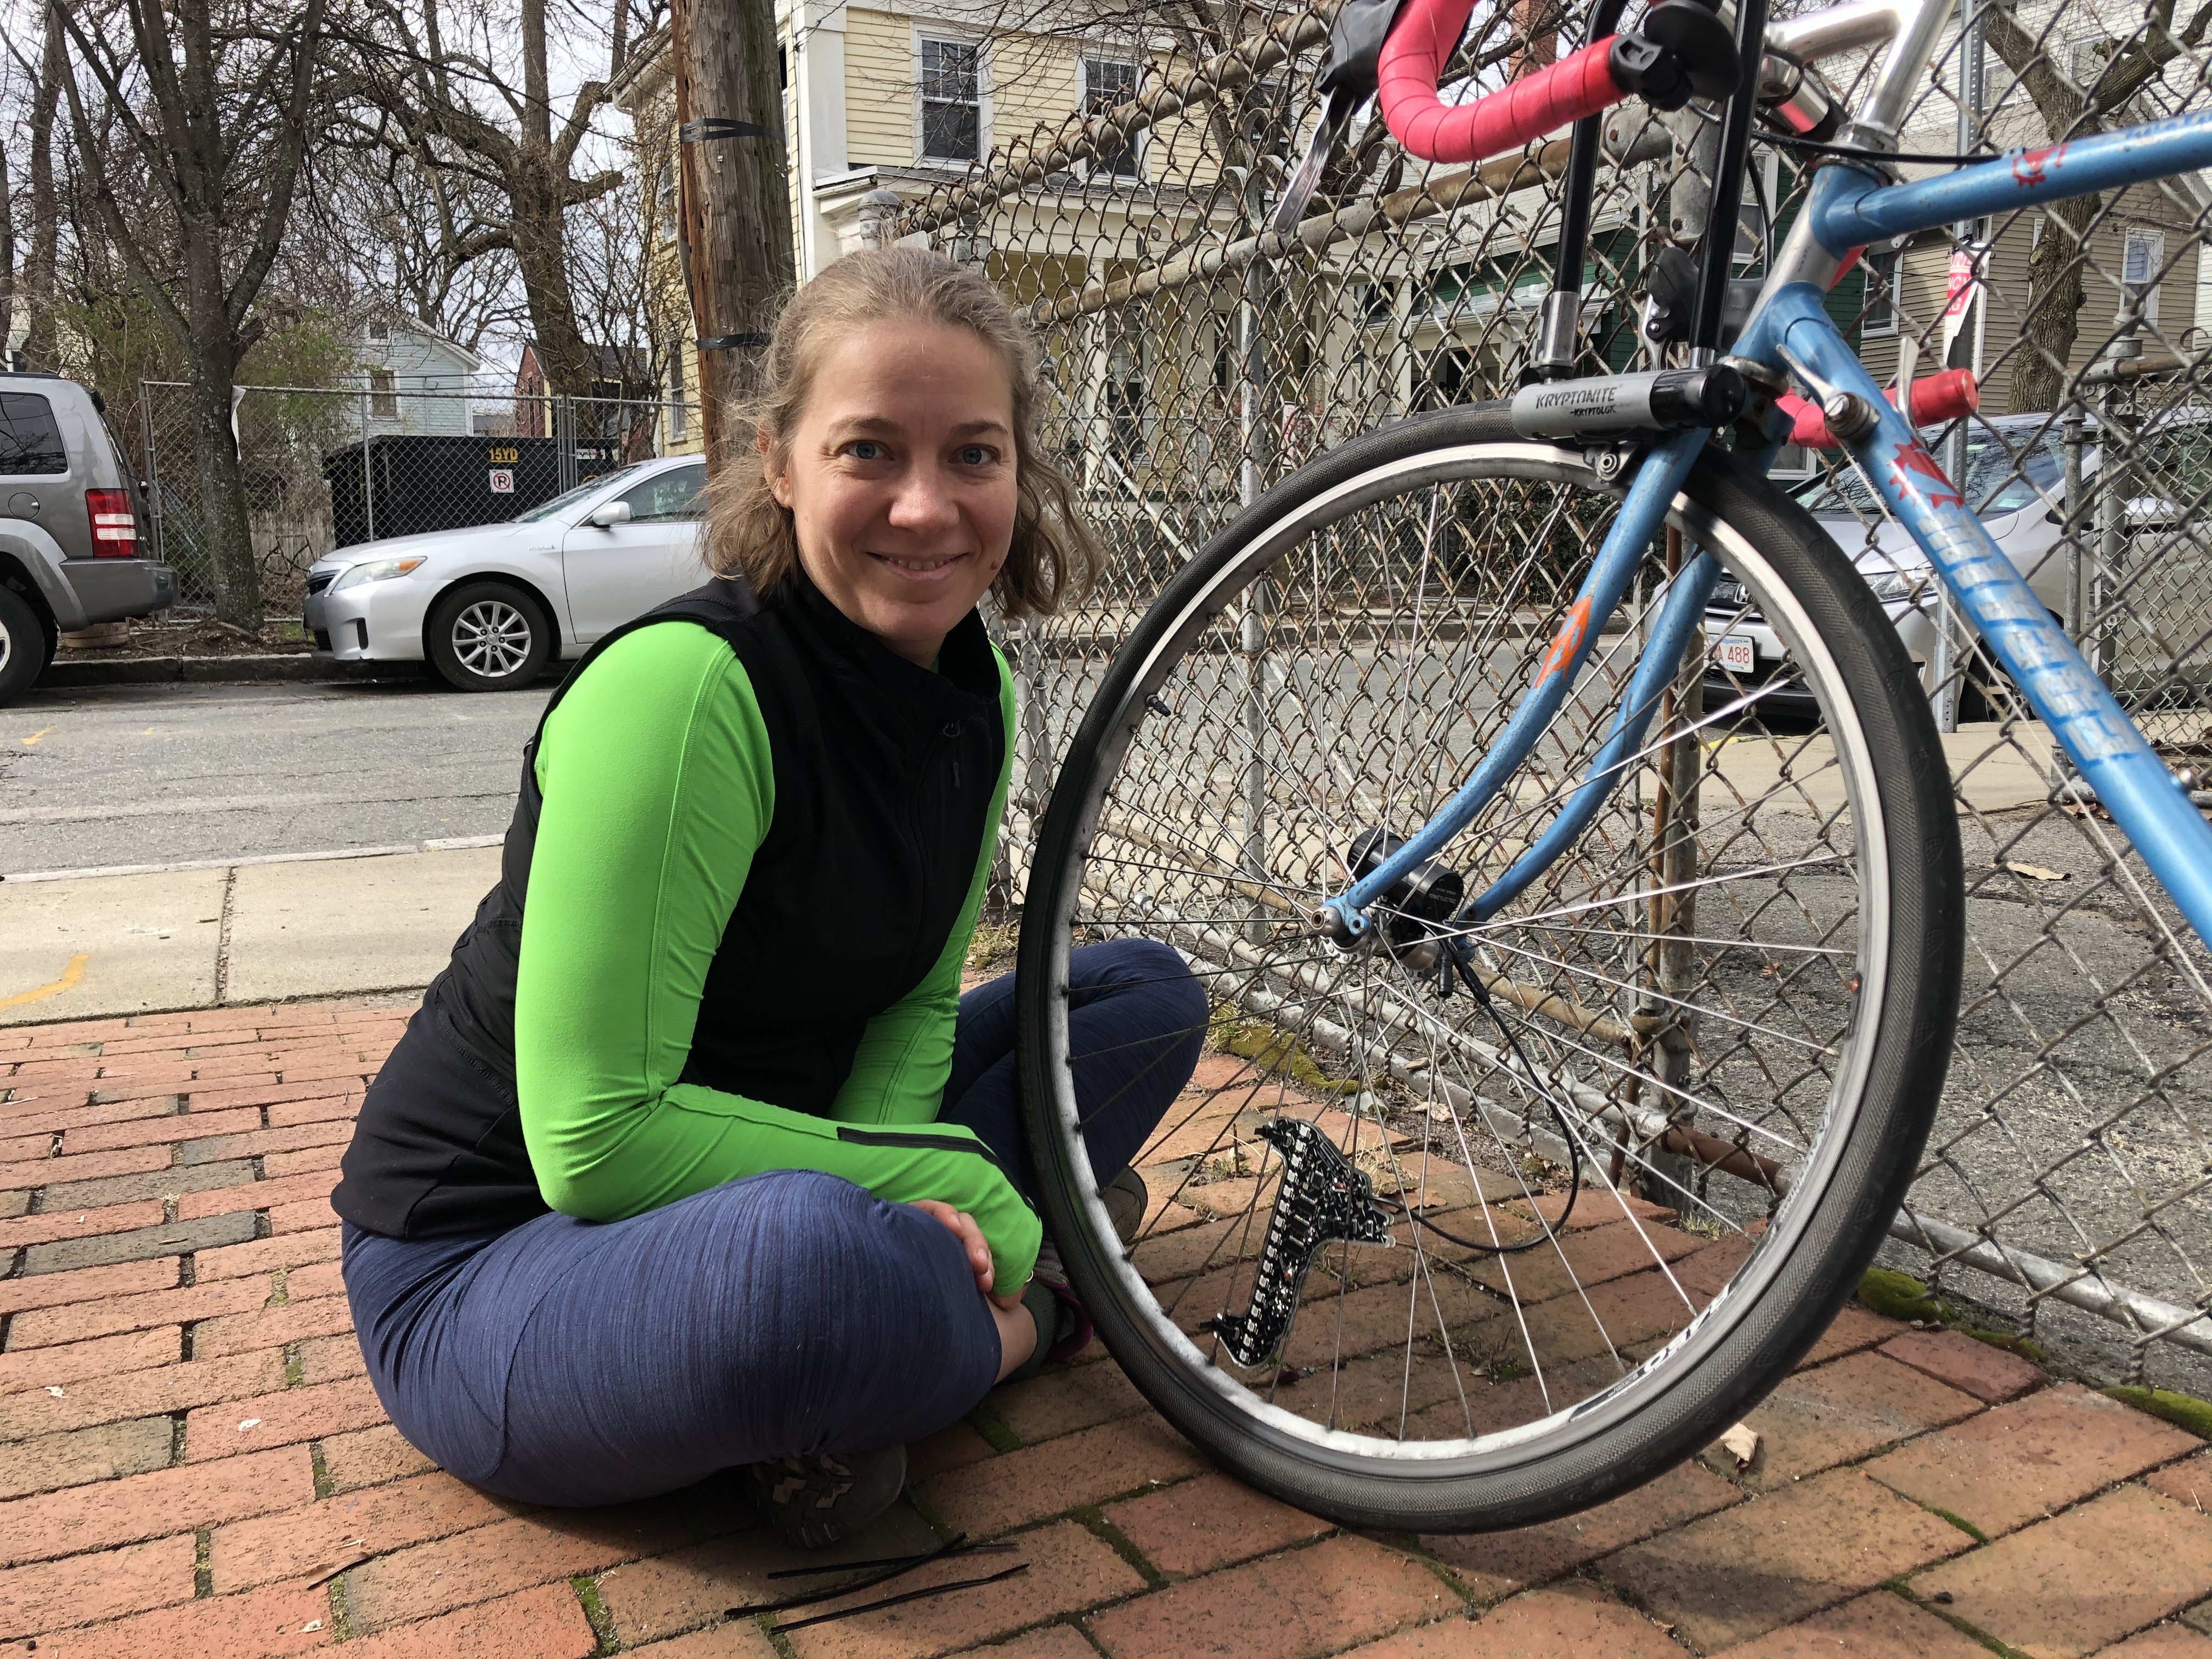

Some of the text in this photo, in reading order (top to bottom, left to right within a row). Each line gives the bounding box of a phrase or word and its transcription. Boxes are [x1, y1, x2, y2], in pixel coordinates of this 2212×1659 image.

[1536, 387, 1617, 409] KRYPTONITE
[489, 448, 518, 461] 15YD
[1728, 646, 1749, 663] 488
